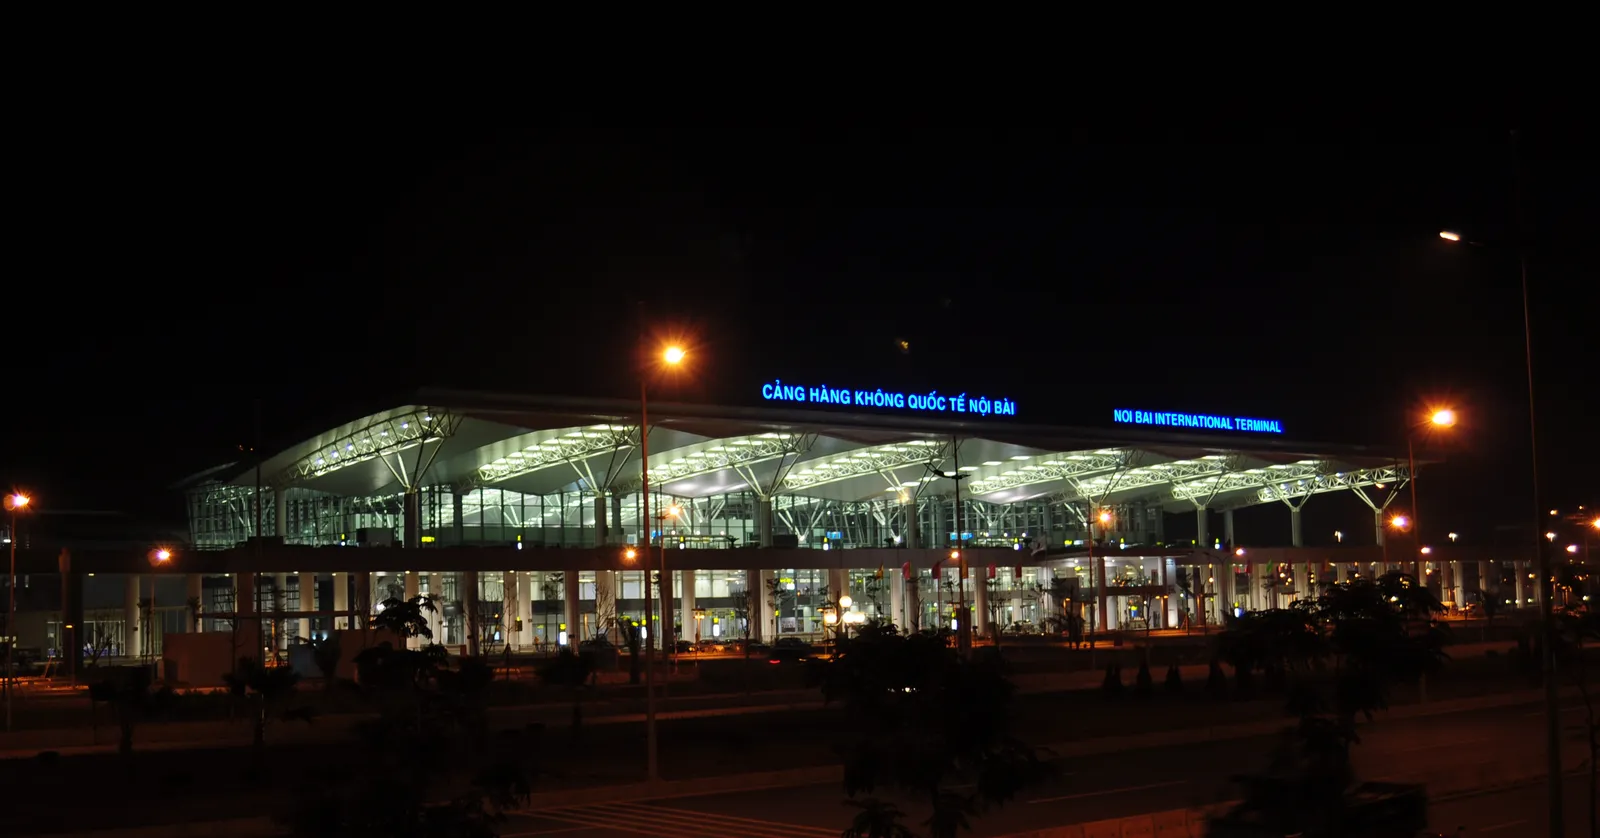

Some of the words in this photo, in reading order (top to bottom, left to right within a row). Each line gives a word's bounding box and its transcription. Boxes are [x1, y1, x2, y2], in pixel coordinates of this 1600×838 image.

[762, 379, 805, 401] CẢNG
[809, 384, 851, 404] HÀNG
[854, 388, 905, 408] KHÔNG
[908, 390, 946, 411] QUỐC
[949, 392, 966, 412] TẾ
[969, 398, 991, 416] NỘI
[994, 398, 1016, 416] BÀI
[1113, 409, 1133, 422] NOI
[1135, 411, 1153, 424] BAI
[1155, 412, 1233, 430] INTERNATIONAL
[1235, 418, 1282, 433] TERMINAL
